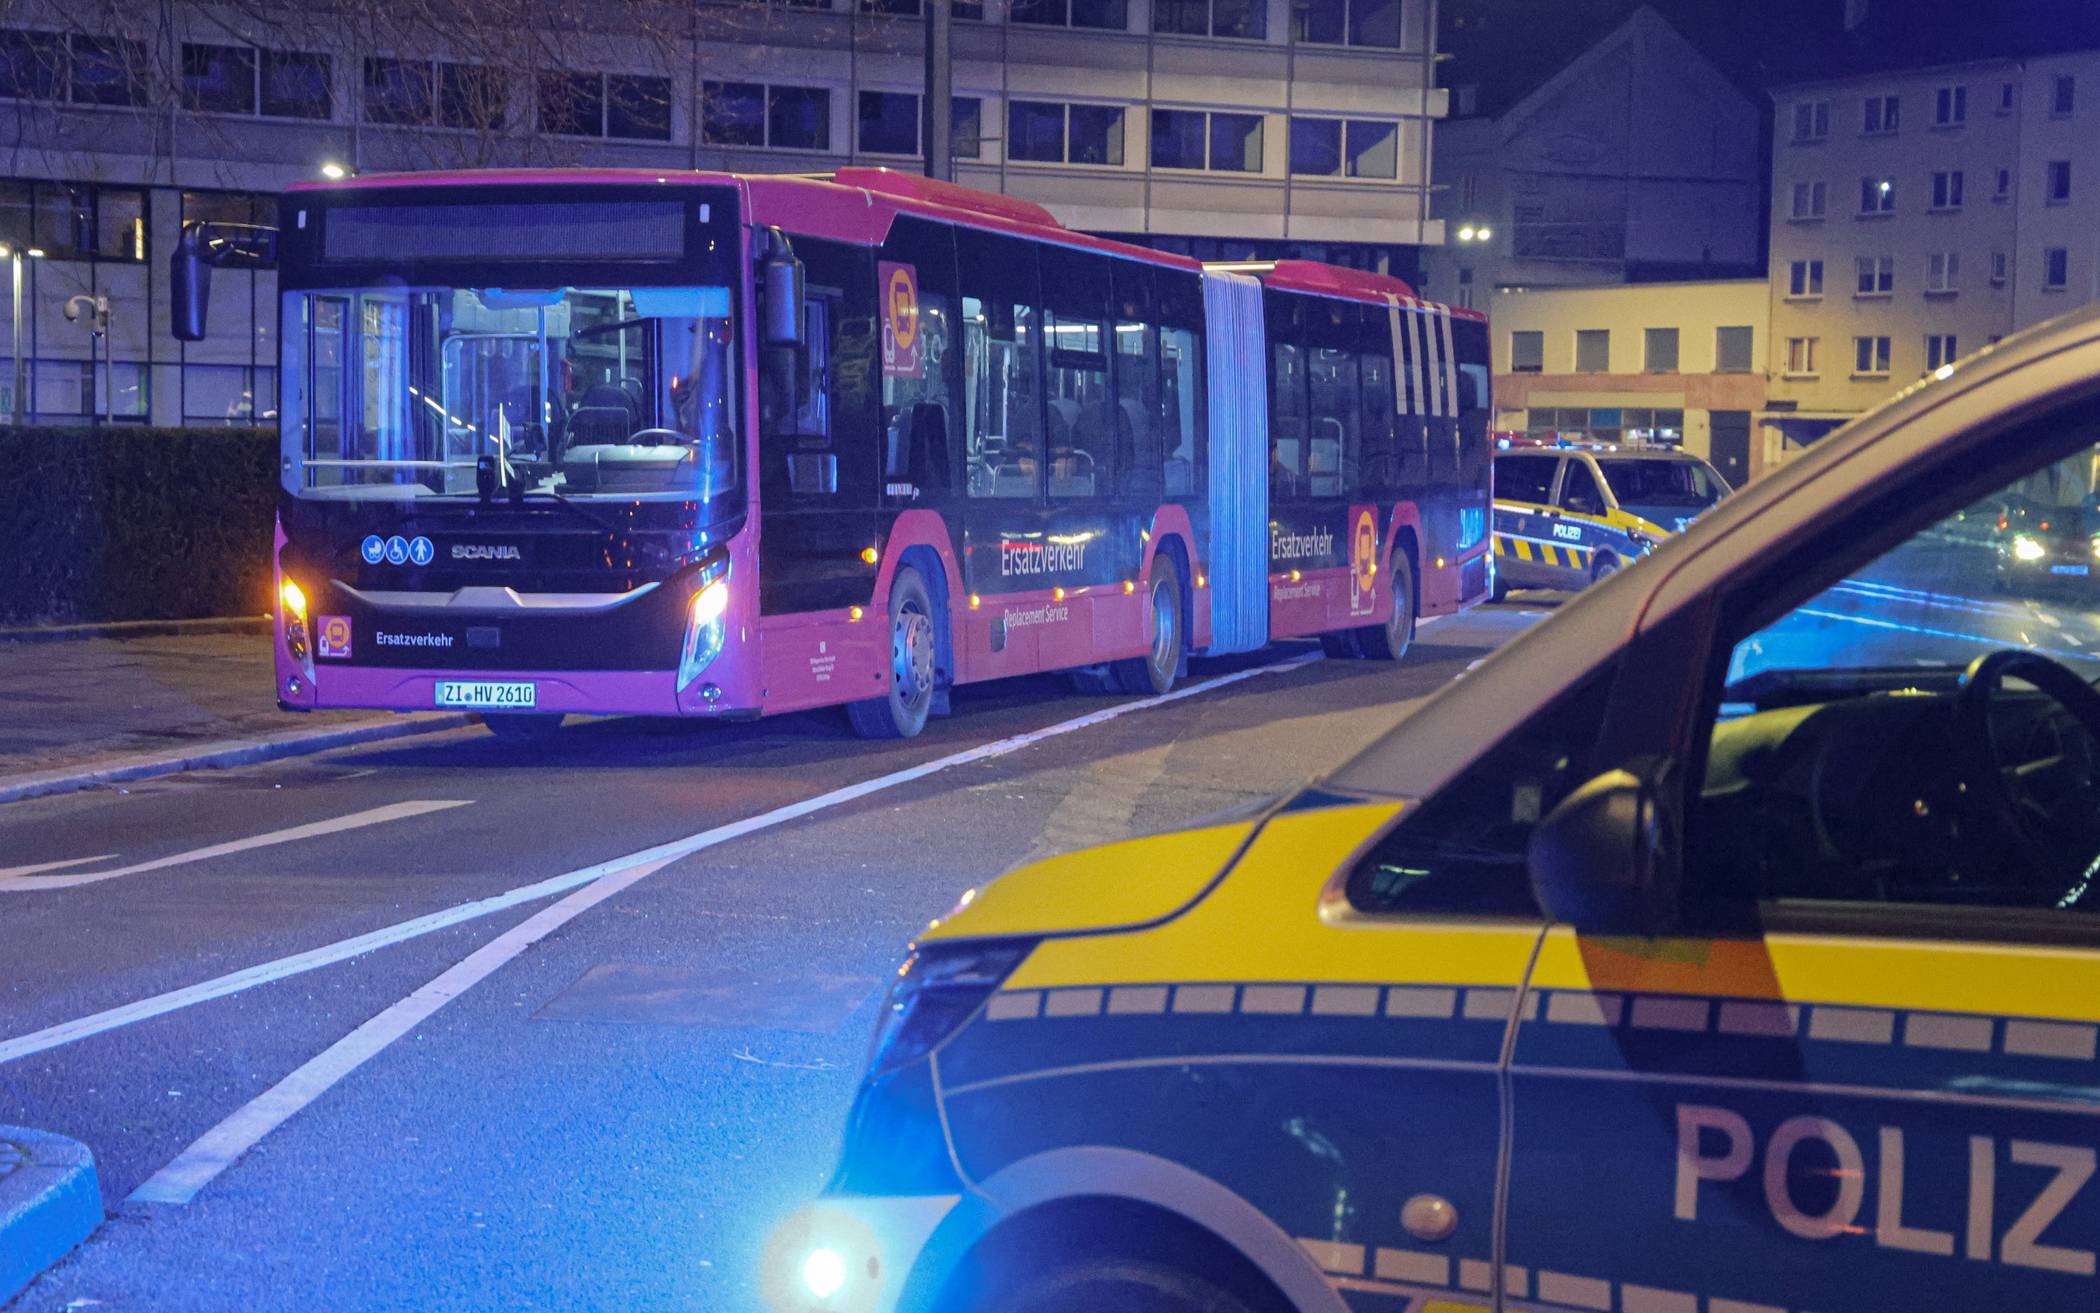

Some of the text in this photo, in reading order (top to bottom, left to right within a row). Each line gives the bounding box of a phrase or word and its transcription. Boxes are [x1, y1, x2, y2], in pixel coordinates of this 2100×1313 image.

[1272, 526, 1333, 559] Ersatzverkehr
[1553, 523, 1581, 540] POLIZEI
[451, 545, 520, 560] SCANIA
[1002, 538, 1085, 576] Ersatzverkehr
[1004, 604, 1069, 631] Replacement Service
[376, 631, 454, 648] Ersatzverkehr
[445, 685, 532, 703] ZI HV 2610
[1674, 1103, 2097, 1276] POLIZ
